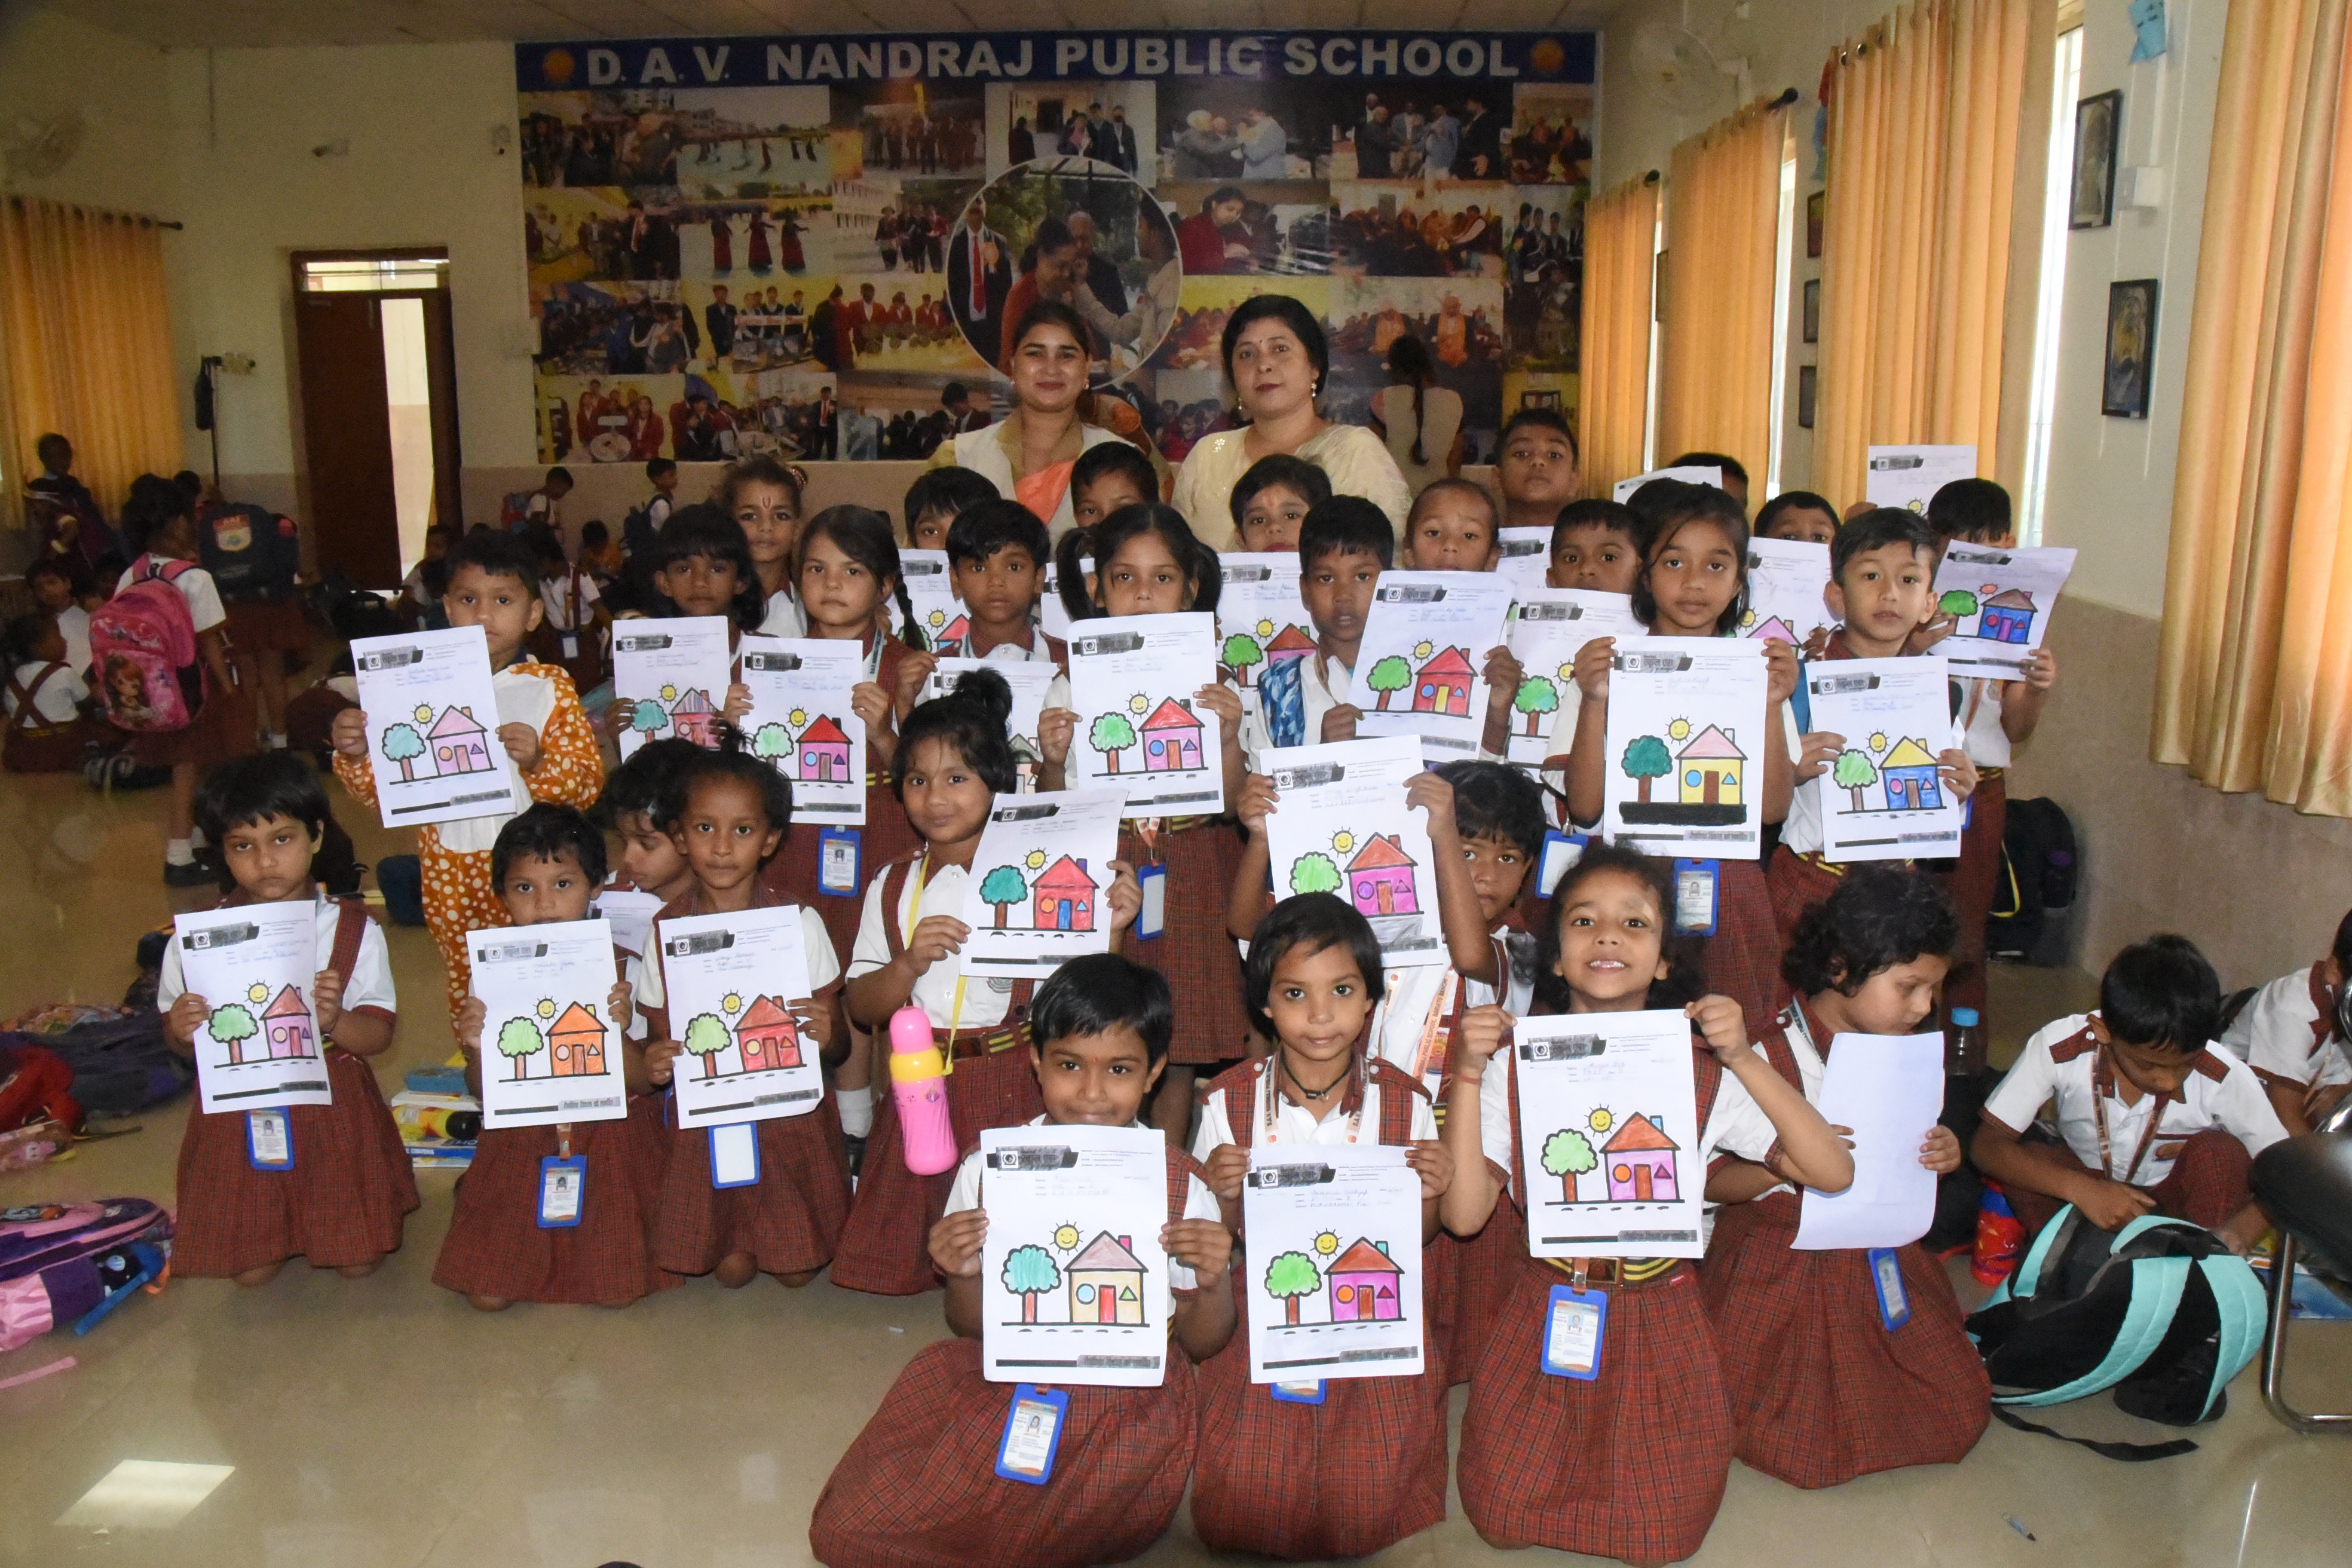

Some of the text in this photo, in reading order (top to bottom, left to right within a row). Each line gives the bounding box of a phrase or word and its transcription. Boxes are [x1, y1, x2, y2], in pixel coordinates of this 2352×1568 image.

[767, 39, 1033, 81] NANDRAJ
[1055, 37, 1264, 76] PUBLIC
[1283, 37, 1519, 76] SCHOOL
[1423, 1039, 1431, 1056] PUBLIC
[1434, 997, 1442, 1017] BARIATU
